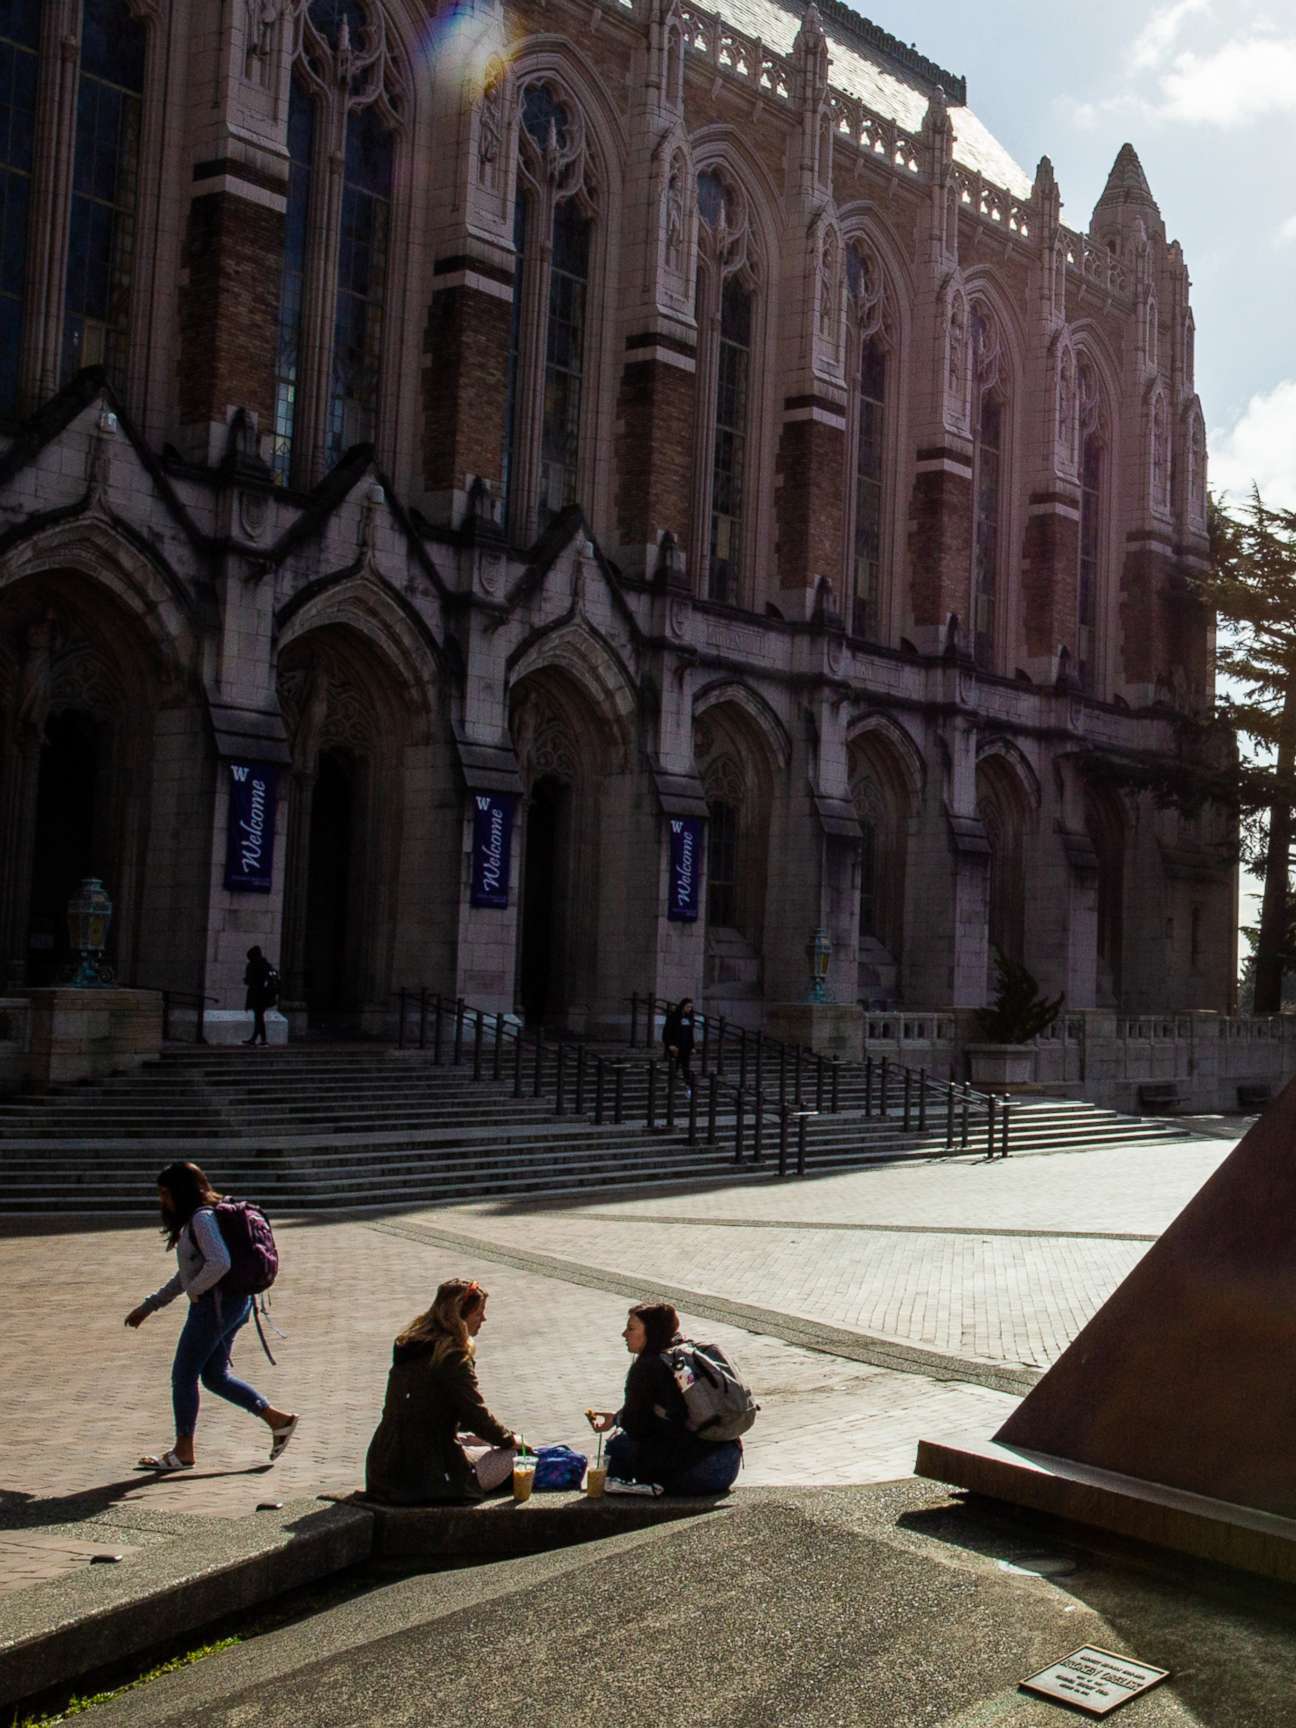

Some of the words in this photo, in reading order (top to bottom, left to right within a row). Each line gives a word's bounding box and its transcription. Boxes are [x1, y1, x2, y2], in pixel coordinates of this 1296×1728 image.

[230, 764, 251, 783] W
[240, 779, 266, 873] Welcome
[475, 795, 491, 811] W
[670, 819, 684, 834] W
[481, 808, 504, 892] Welcome
[676, 831, 693, 906] Welcome
